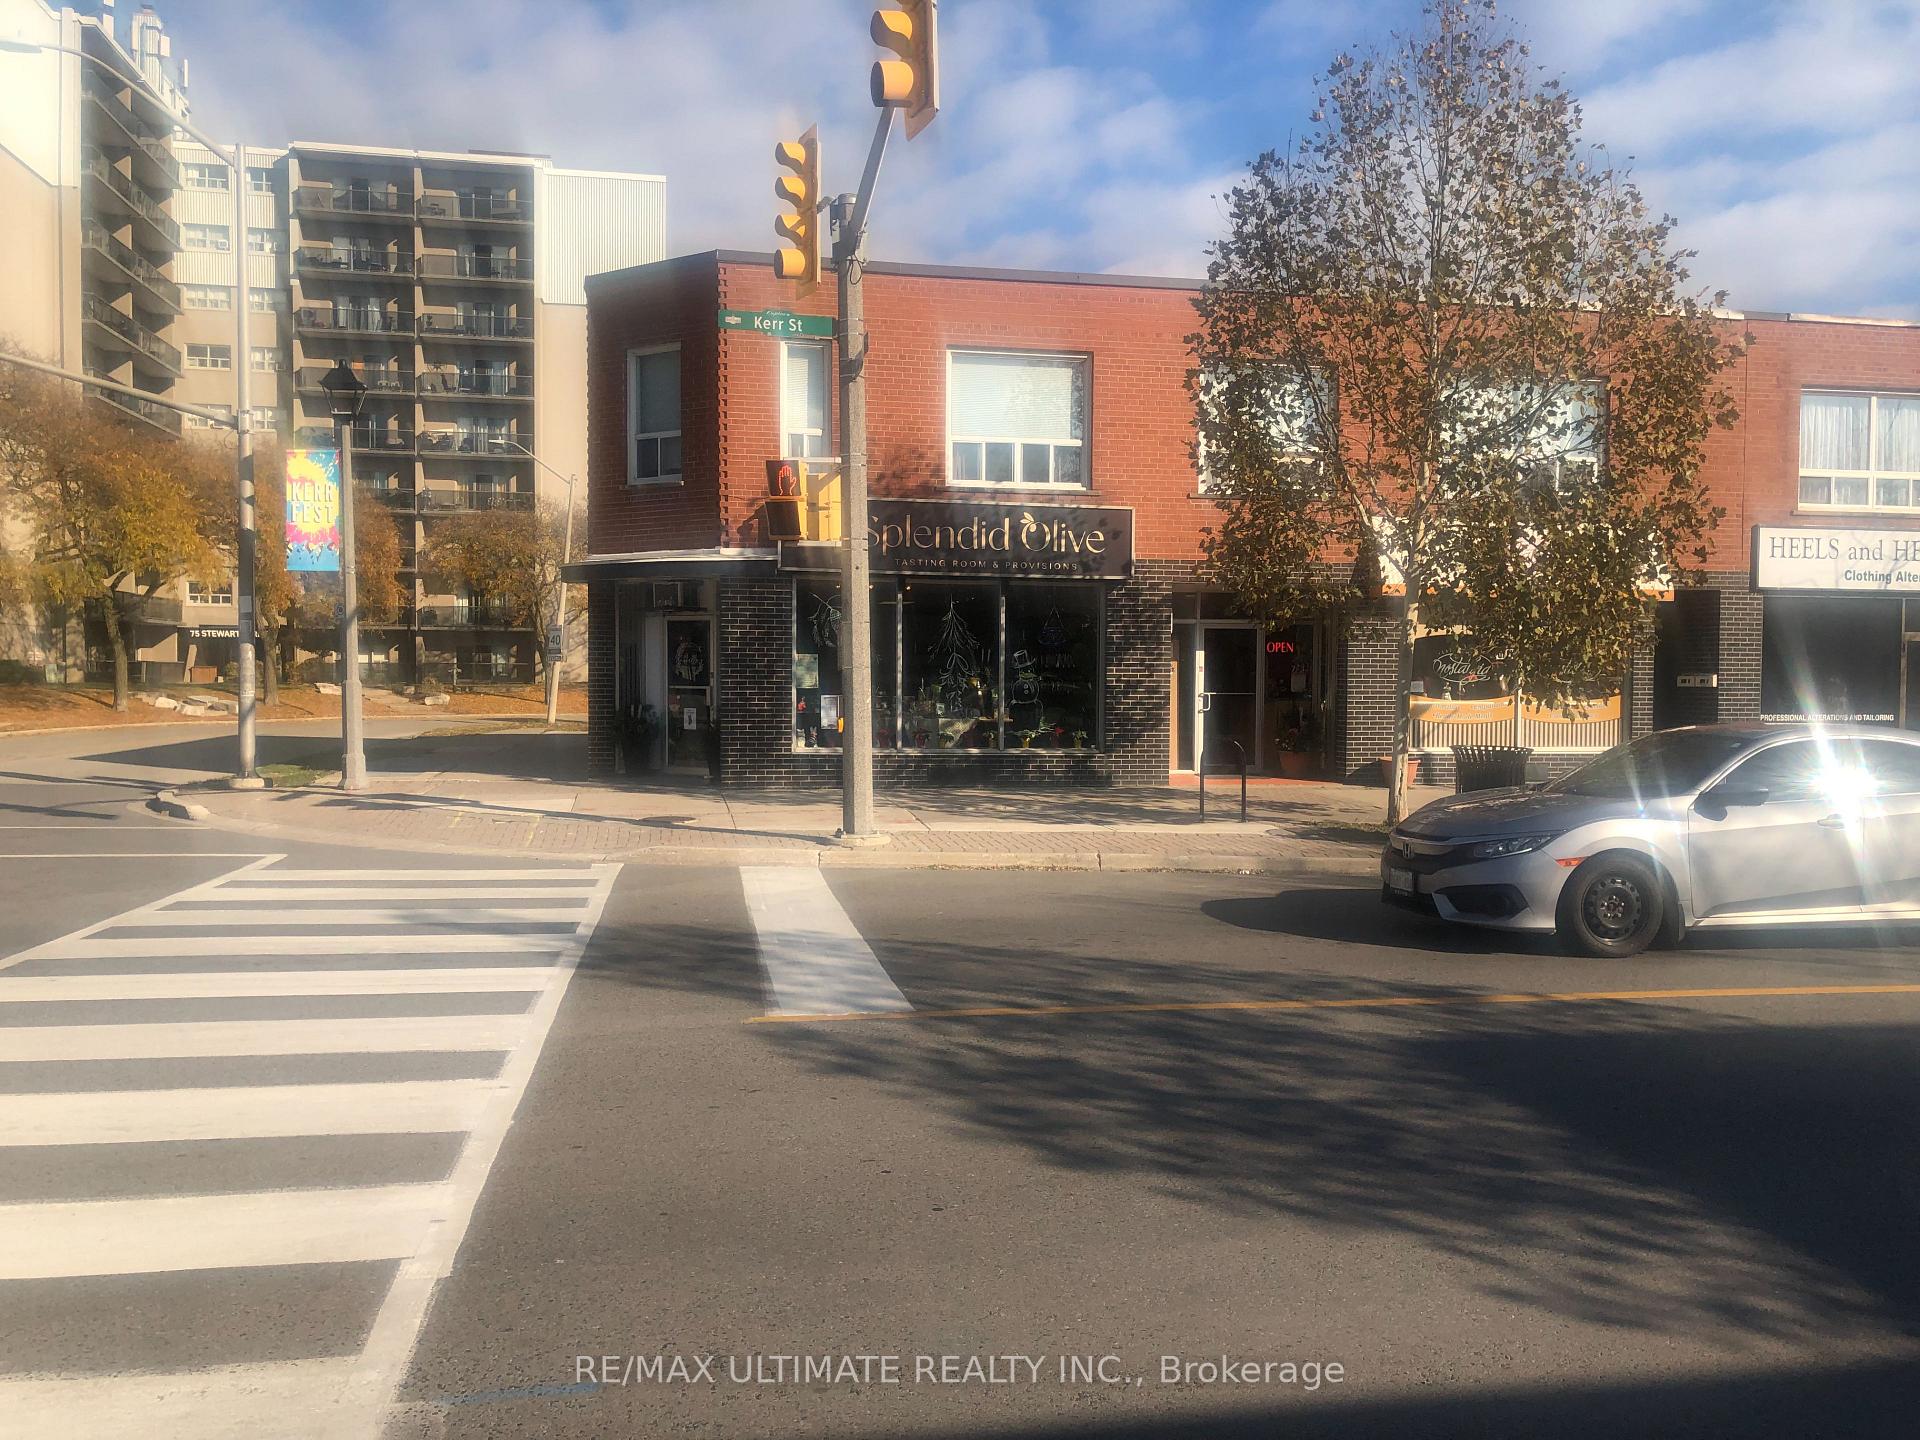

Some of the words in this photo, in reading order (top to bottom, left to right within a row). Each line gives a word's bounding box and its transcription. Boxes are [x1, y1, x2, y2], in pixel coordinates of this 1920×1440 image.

[754, 316, 784, 330] Kerr
[788, 318, 803, 332] St
[291, 482, 333, 502] KERR
[291, 502, 333, 523] FEST
[1020, 512, 1106, 554] Olive
[1769, 536, 1839, 560] HEELS
[1848, 539, 1883, 561] and
[895, 558, 946, 568] TASTING
[953, 560, 987, 569] ROOM
[992, 561, 1000, 569] &
[1005, 561, 1079, 571] PROVISIONS
[1844, 569, 1892, 585] Clothing
[1895, 571, 1920, 583] Alte
[189, 630, 200, 638] 75
[201, 630, 239, 638] STEWART
[550, 634, 561, 646] 40
[1266, 641, 1295, 653] OPEN
[1760, 713, 1806, 722] PROFESSIONAL
[1808, 713, 1848, 721] ALTERATIONS
[1849, 713, 1862, 721] AND
[1862, 713, 1895, 721] TAILORING
